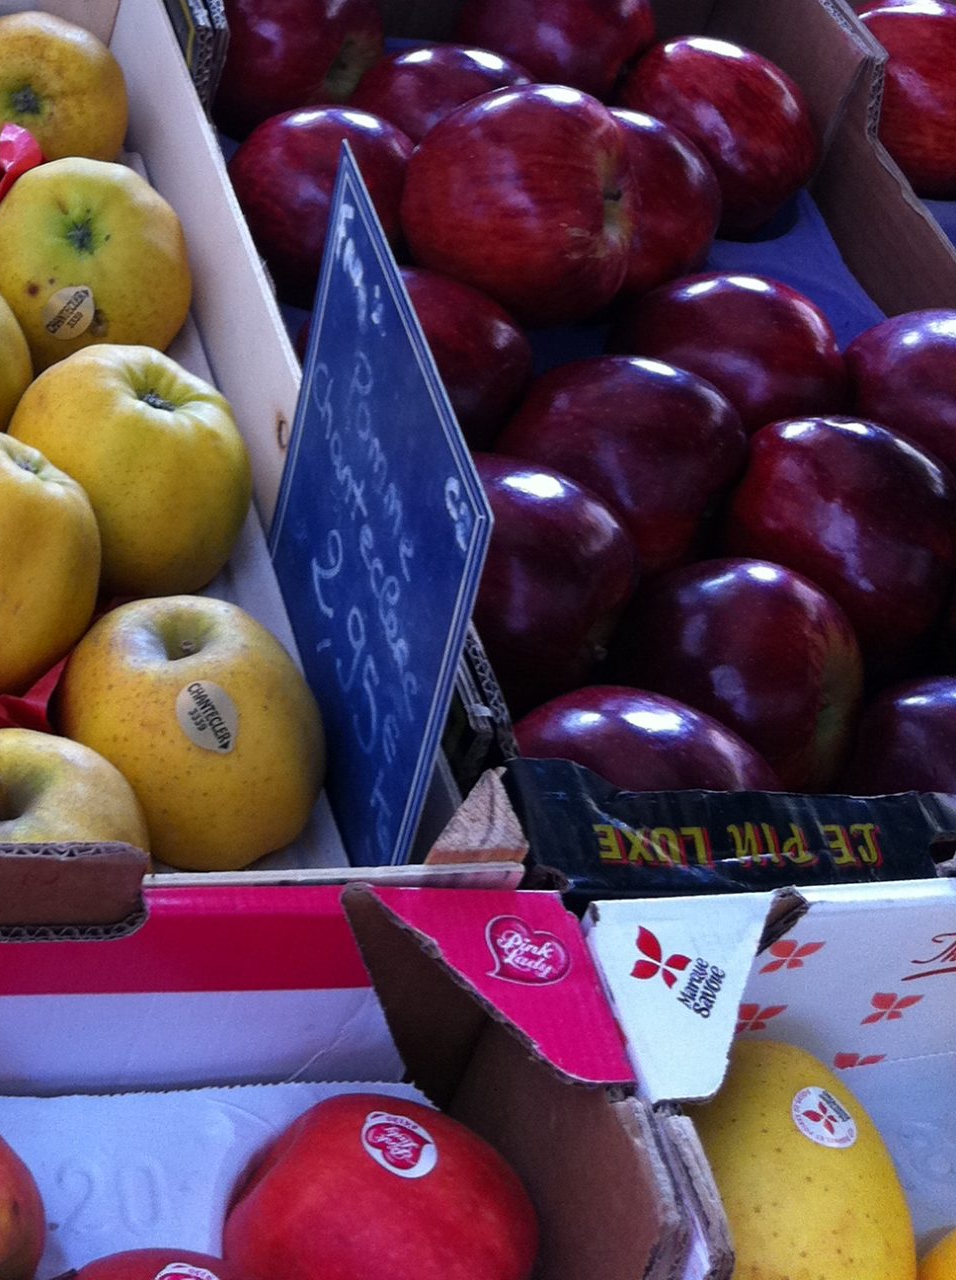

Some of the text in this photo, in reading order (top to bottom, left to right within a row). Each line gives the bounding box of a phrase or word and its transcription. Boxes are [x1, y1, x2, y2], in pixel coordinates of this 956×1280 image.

[46, 288, 87, 334] CHANTECLER
[186, 681, 232, 747] CHANTECLER
[598, 822, 884, 868] LE PIN LUXE
[497, 929, 554, 959] Pink
[503, 949, 553, 979] Lady
[677, 956, 709, 1010] Marque
[692, 965, 726, 1018] Savoie
